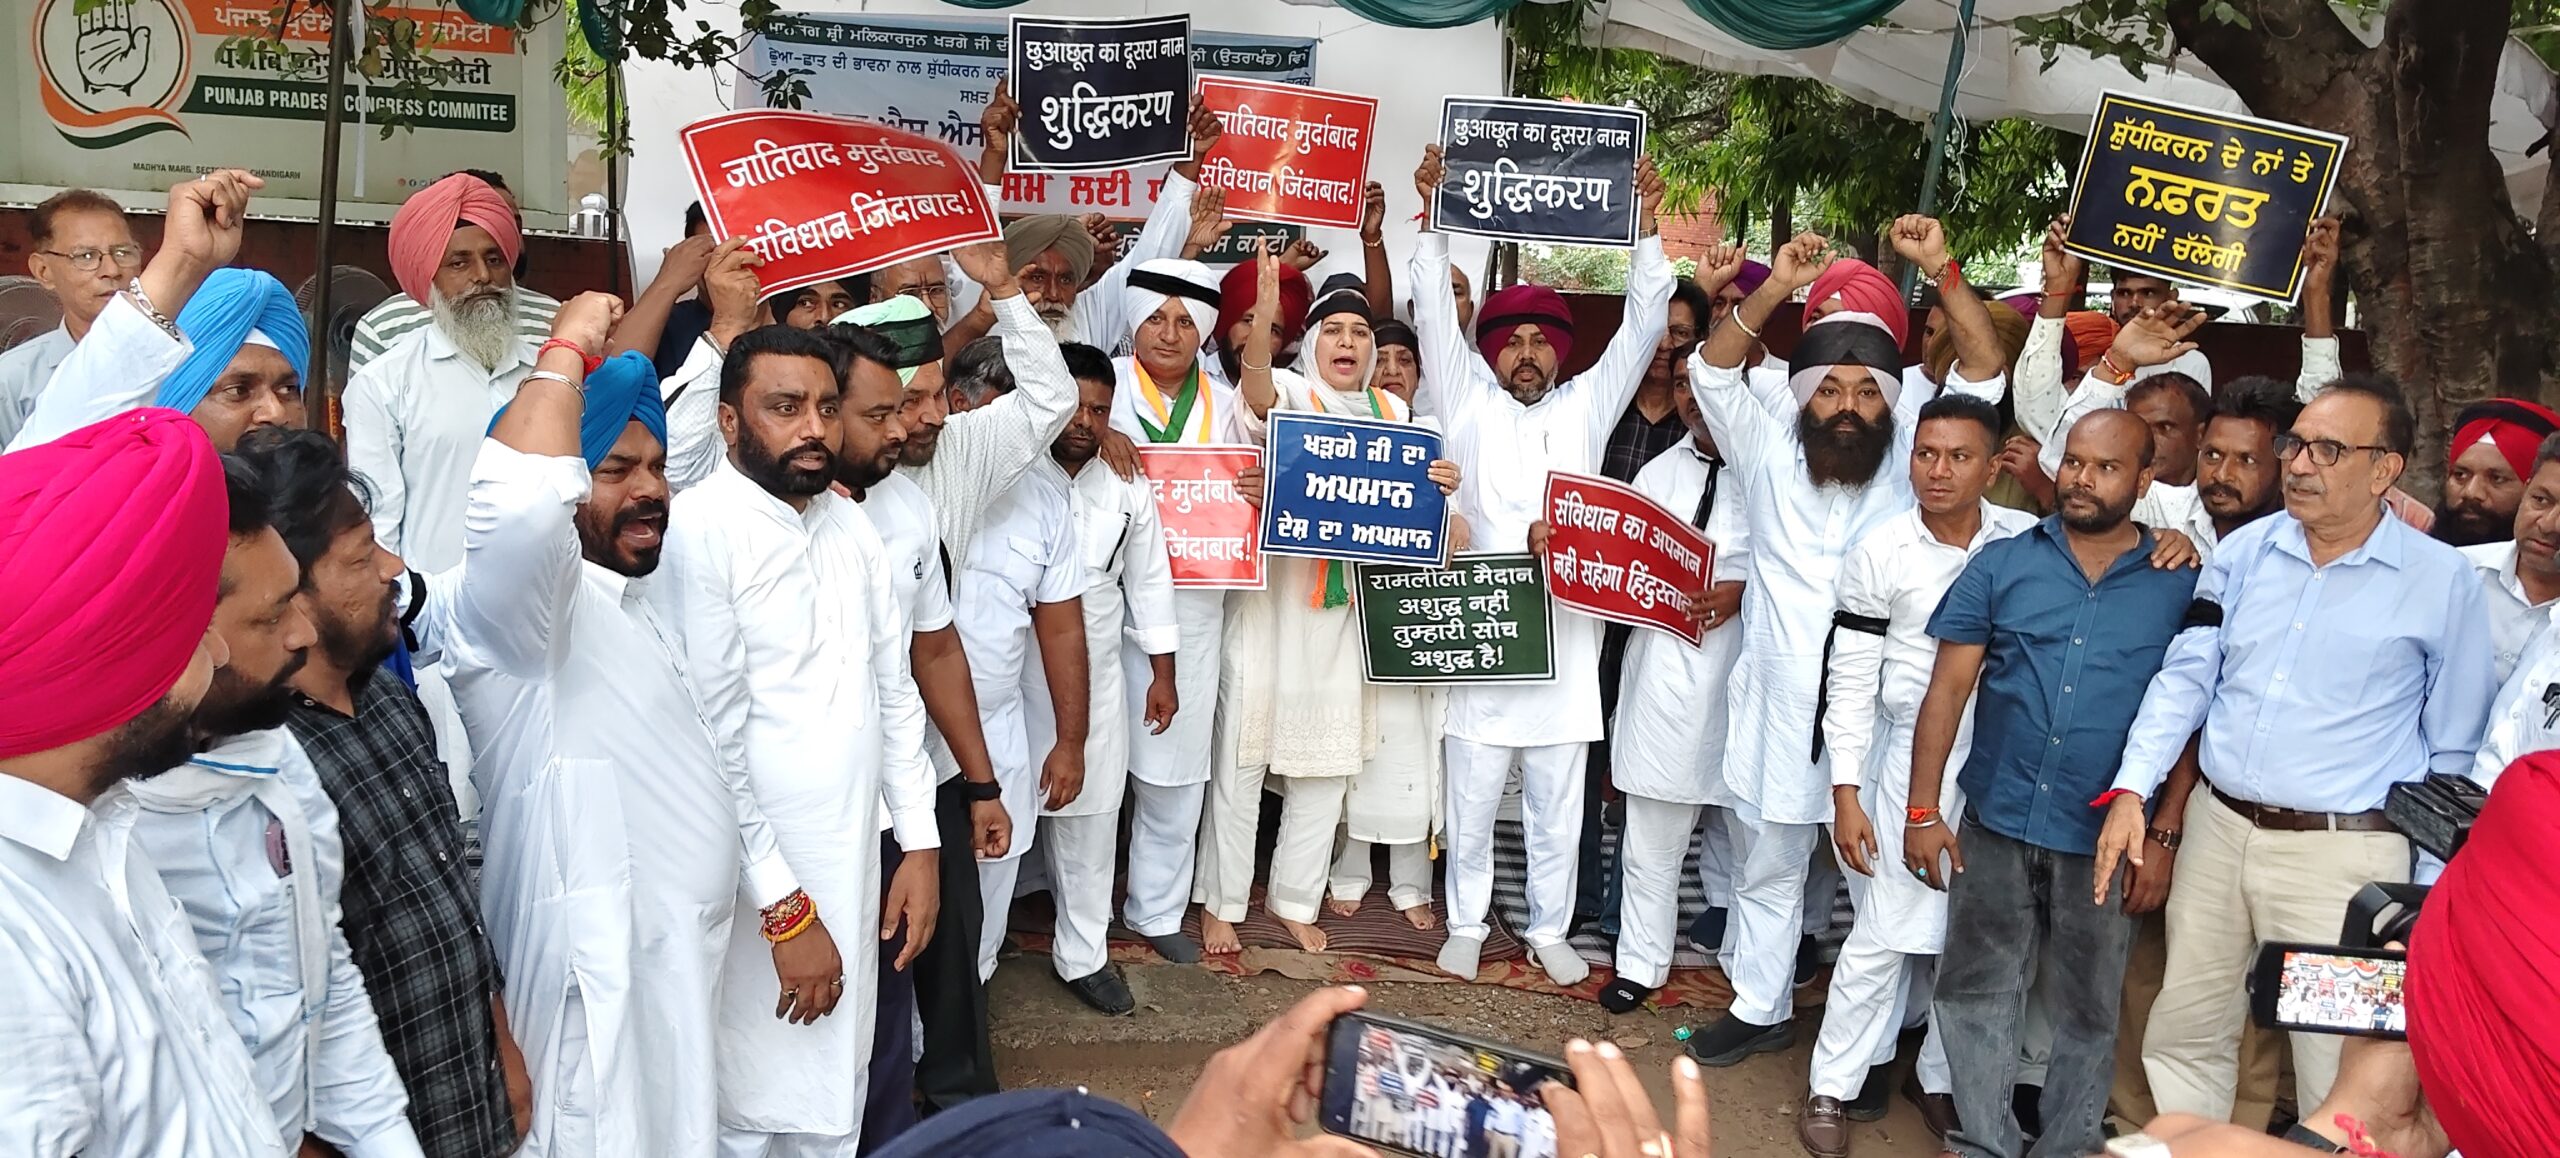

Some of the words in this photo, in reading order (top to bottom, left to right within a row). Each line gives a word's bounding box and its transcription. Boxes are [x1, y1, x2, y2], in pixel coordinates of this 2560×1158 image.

[933, 33, 968, 50] ਖੜਗੇ
[974, 35, 991, 51] ਜੀ
[1025, 40, 1095, 72] छुआछूत
[1099, 43, 1121, 62] का
[1124, 40, 1157, 70] दूसरा
[1161, 37, 1186, 58] नाम
[833, 52, 847, 69] ਦੀ
[853, 57, 891, 72] ਭਾਵਨਾ
[897, 60, 921, 75] ਨਾਲ
[204, 86, 264, 106] PUNJAB
[270, 91, 327, 110] PRADES
[428, 100, 507, 121] COMMITEE
[1040, 81, 1174, 150] शुद्धिकरण
[1294, 114, 1359, 154] मुर्दाबाद
[1454, 118, 1519, 148] छुआछूत
[1523, 123, 1546, 143] का
[1550, 125, 1592, 152] दूसरा
[1597, 128, 1632, 149] नाम
[2110, 115, 2213, 163] ਸ਼ੁੱਧੀਕਰਨ
[2221, 137, 2245, 169] ਦੇ
[2252, 148, 2284, 176] ਨਾਂ
[2291, 152, 2314, 183] ਤੇ
[133, 163, 166, 172] MADHYA
[251, 169, 301, 179] CHANDIGARH
[720, 139, 842, 188] जातिवाद
[842, 138, 946, 174] मुर्दाबाद
[1199, 157, 1274, 194] संविधान
[1279, 165, 1356, 205] जिंदाबाद!
[1070, 170, 1133, 207] ਲਈ
[1463, 157, 1613, 219] शुद्धिकरण
[746, 211, 854, 262] संविधान
[852, 189, 974, 235] जिंदाबाद!
[2113, 223, 2167, 254] ਨਹੀਂ
[2172, 231, 2247, 272] ਚੱਲੇਗੀ
[1304, 432, 1358, 460] ਖੜਗੇ
[1367, 437, 1392, 463] ਜੀ
[1402, 444, 1426, 465] ਦਾ
[1305, 472, 1415, 509] ਅਪਮਾਨ
[1278, 510, 1309, 541] ਦੇਸ਼
[1318, 520, 1343, 541] ਦਾ
[1351, 523, 1433, 550] ਅਪਮਾਨ
[1554, 490, 1620, 536] संविधान
[1622, 512, 1648, 543] का
[1649, 526, 1702, 579] अपमान
[1370, 568, 1467, 590] रामलीला
[1473, 562, 1534, 586] मैदान
[1580, 551, 1625, 594] सहेगा
[1399, 596, 1463, 621] अशुद्ध
[1468, 589, 1510, 615] नहीं
[1393, 618, 1466, 648] तुम्हारी
[1471, 616, 1519, 640] सोच
[1410, 649, 1474, 673] अशुद्ध
